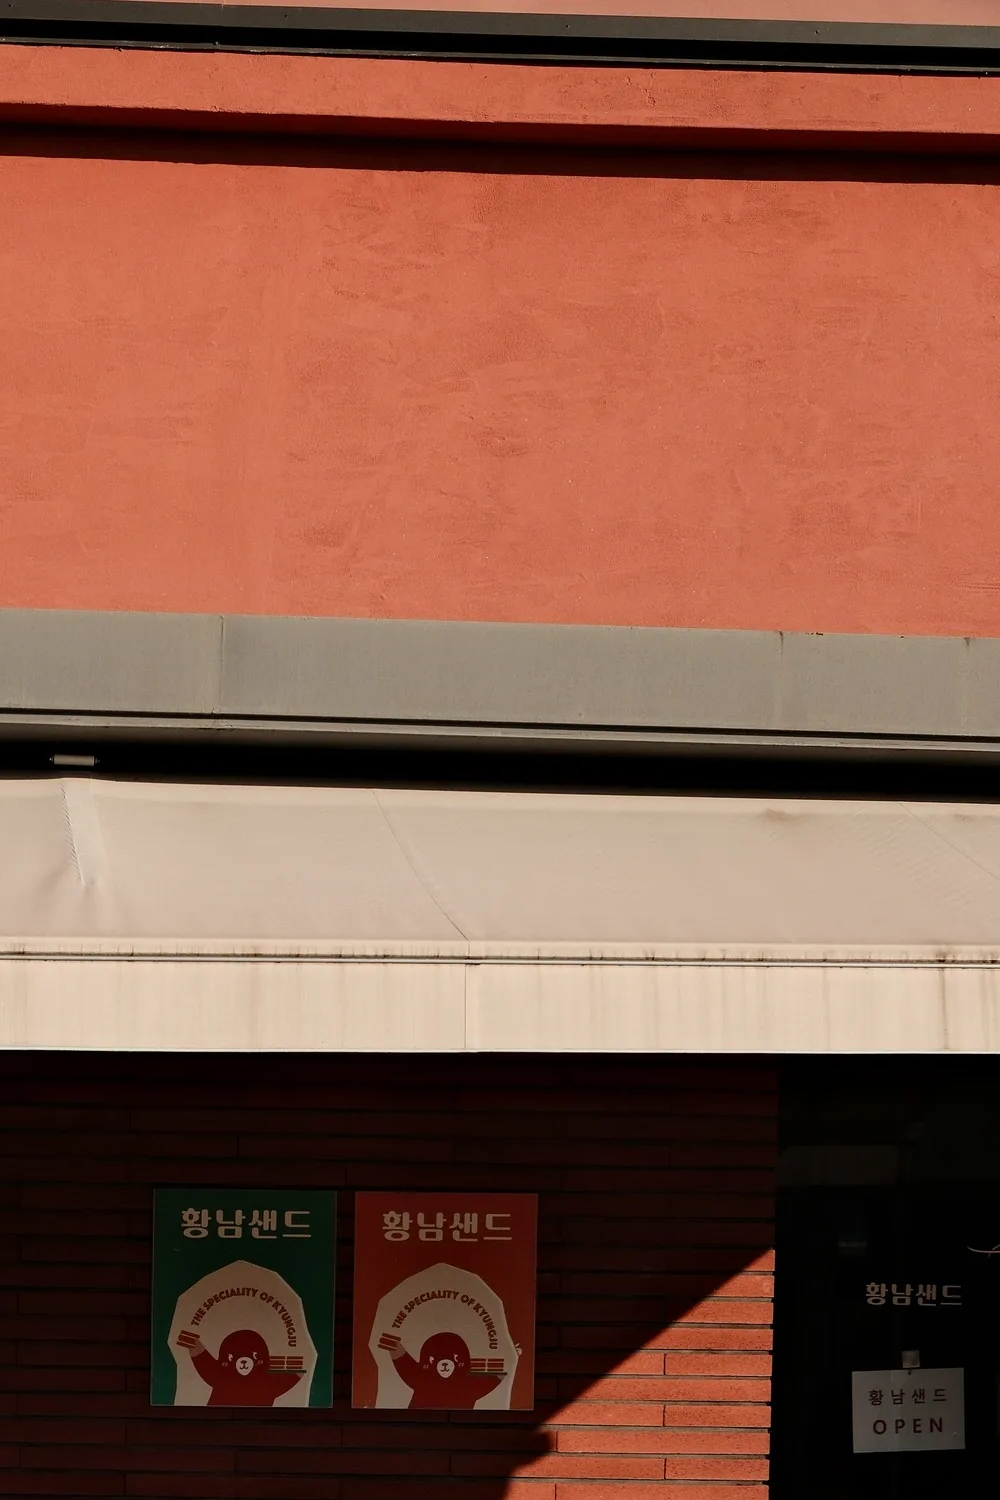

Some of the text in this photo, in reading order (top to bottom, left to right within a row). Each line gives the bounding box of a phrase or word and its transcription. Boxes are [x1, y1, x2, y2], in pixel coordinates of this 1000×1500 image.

[181, 1208, 312, 1239] 황남샌드
[382, 1211, 513, 1241] 황남샌드
[866, 1283, 962, 1306] 황남샌드
[191, 1287, 297, 1347] THE SPECIALITY OF KYUNGJU
[392, 1290, 498, 1349] THE SPECIALITY OF KYUNGJU
[868, 1388, 947, 1406] 황남샌드
[872, 1418, 944, 1435] OPEN
